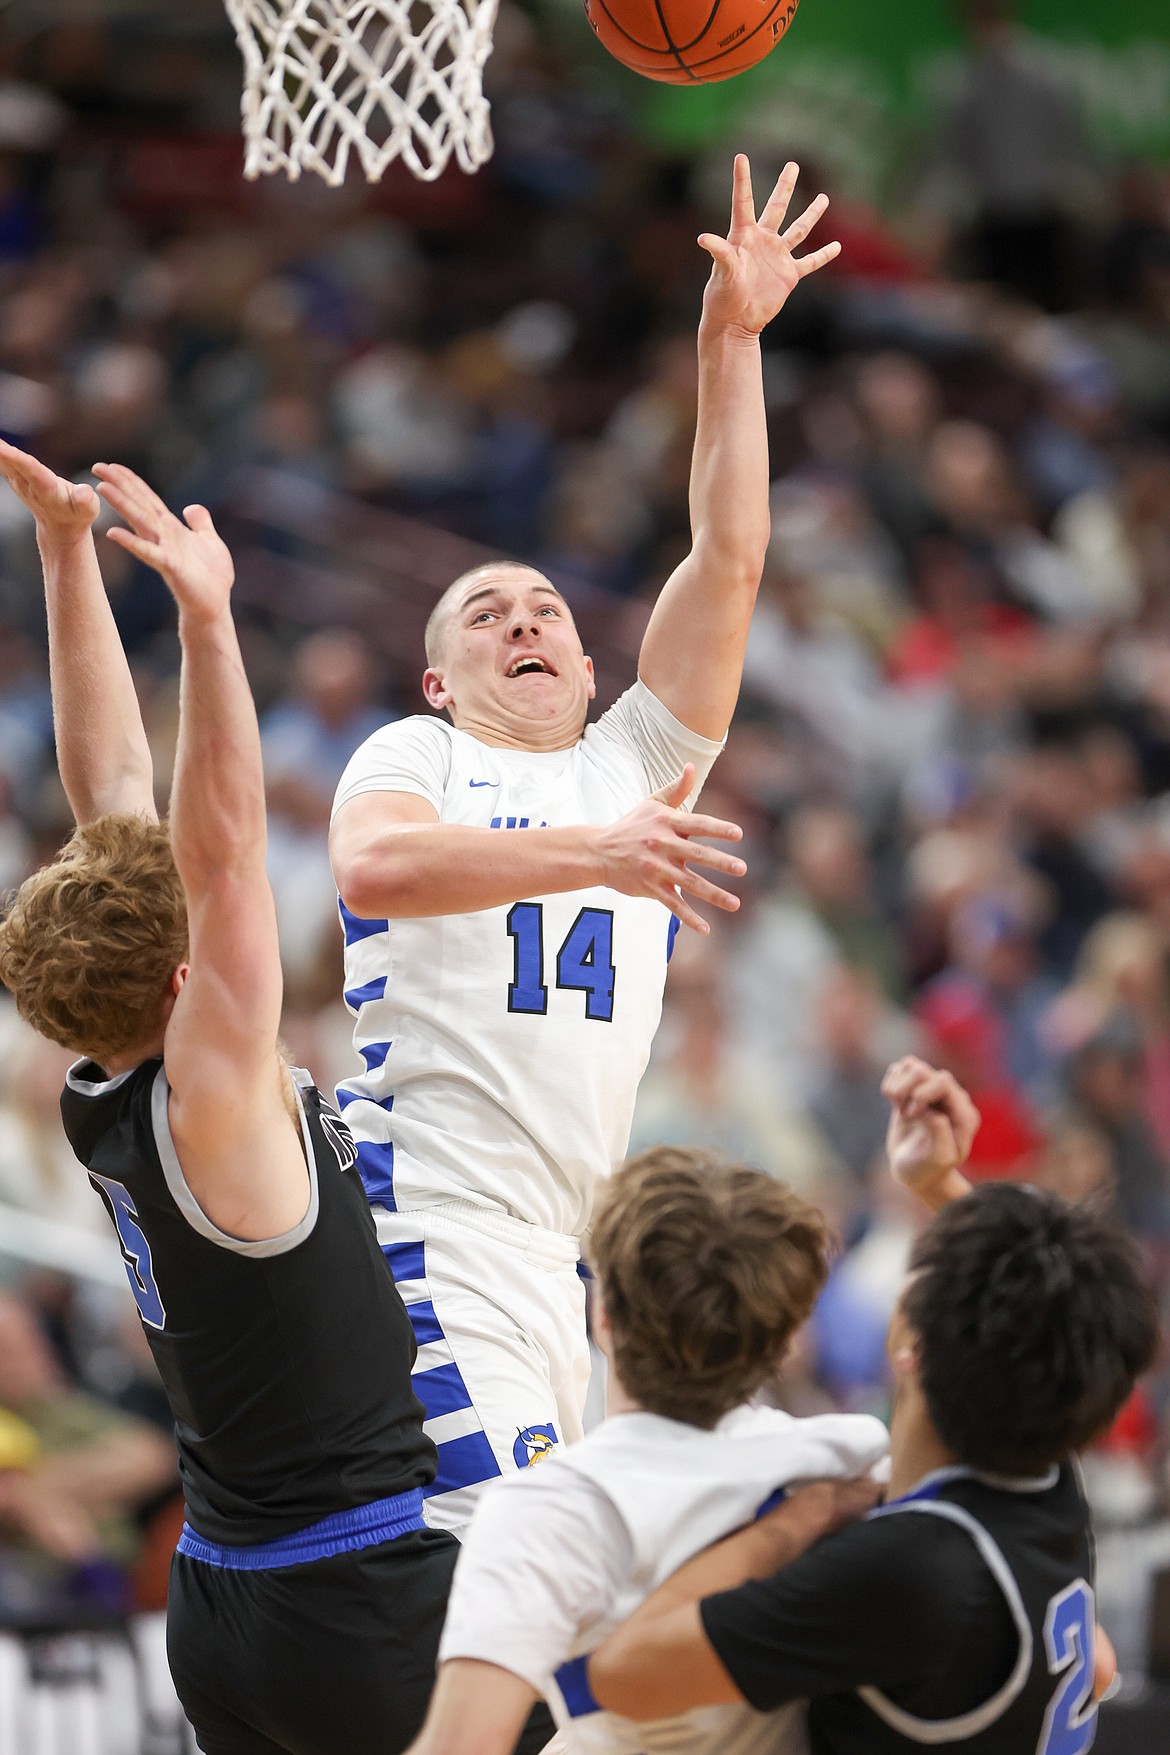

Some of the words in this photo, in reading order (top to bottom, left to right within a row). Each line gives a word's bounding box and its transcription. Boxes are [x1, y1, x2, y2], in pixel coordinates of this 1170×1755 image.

[506, 901, 616, 1023] 14
[88, 1170, 166, 1331] 5
[1035, 1577, 1100, 1755] 2
